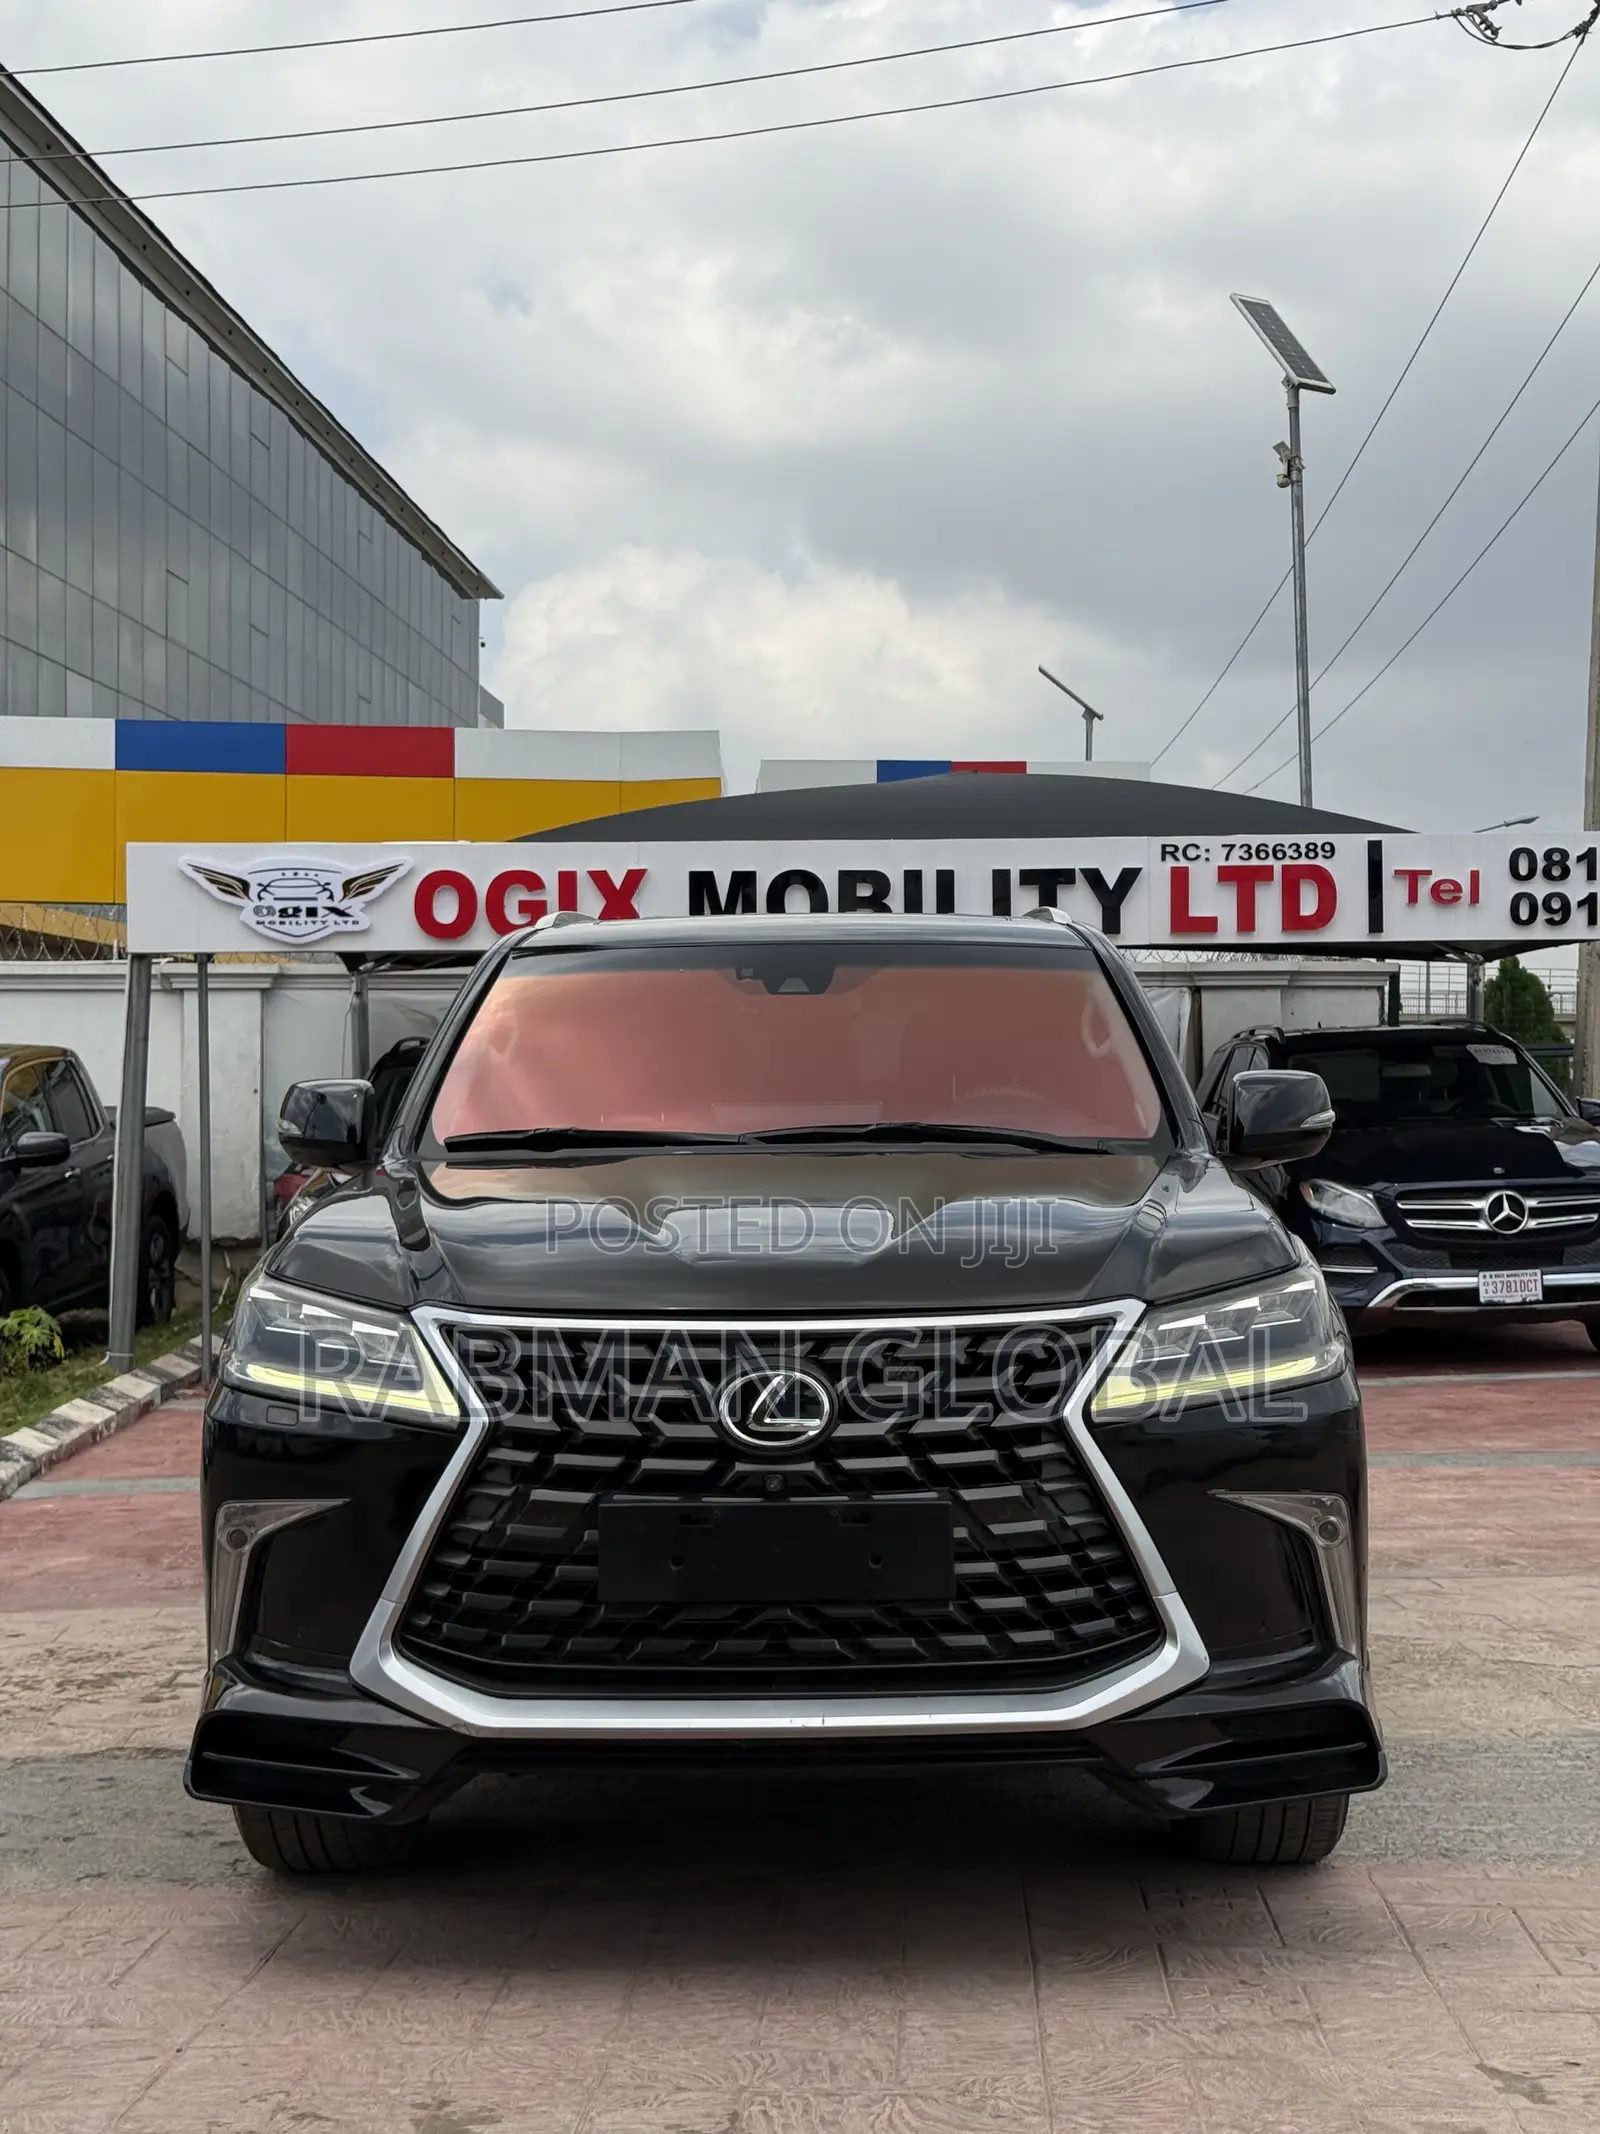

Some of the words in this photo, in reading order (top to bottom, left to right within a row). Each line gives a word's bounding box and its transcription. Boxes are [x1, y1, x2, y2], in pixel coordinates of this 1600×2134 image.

[1160, 843, 1211, 862] RC:
[1220, 841, 1336, 862] 7366389
[1508, 846, 1598, 882] 081
[413, 868, 648, 940] OGIX
[1169, 863, 1338, 934] LTD
[1393, 869, 1481, 905] Tel
[1509, 891, 1599, 927] 091
